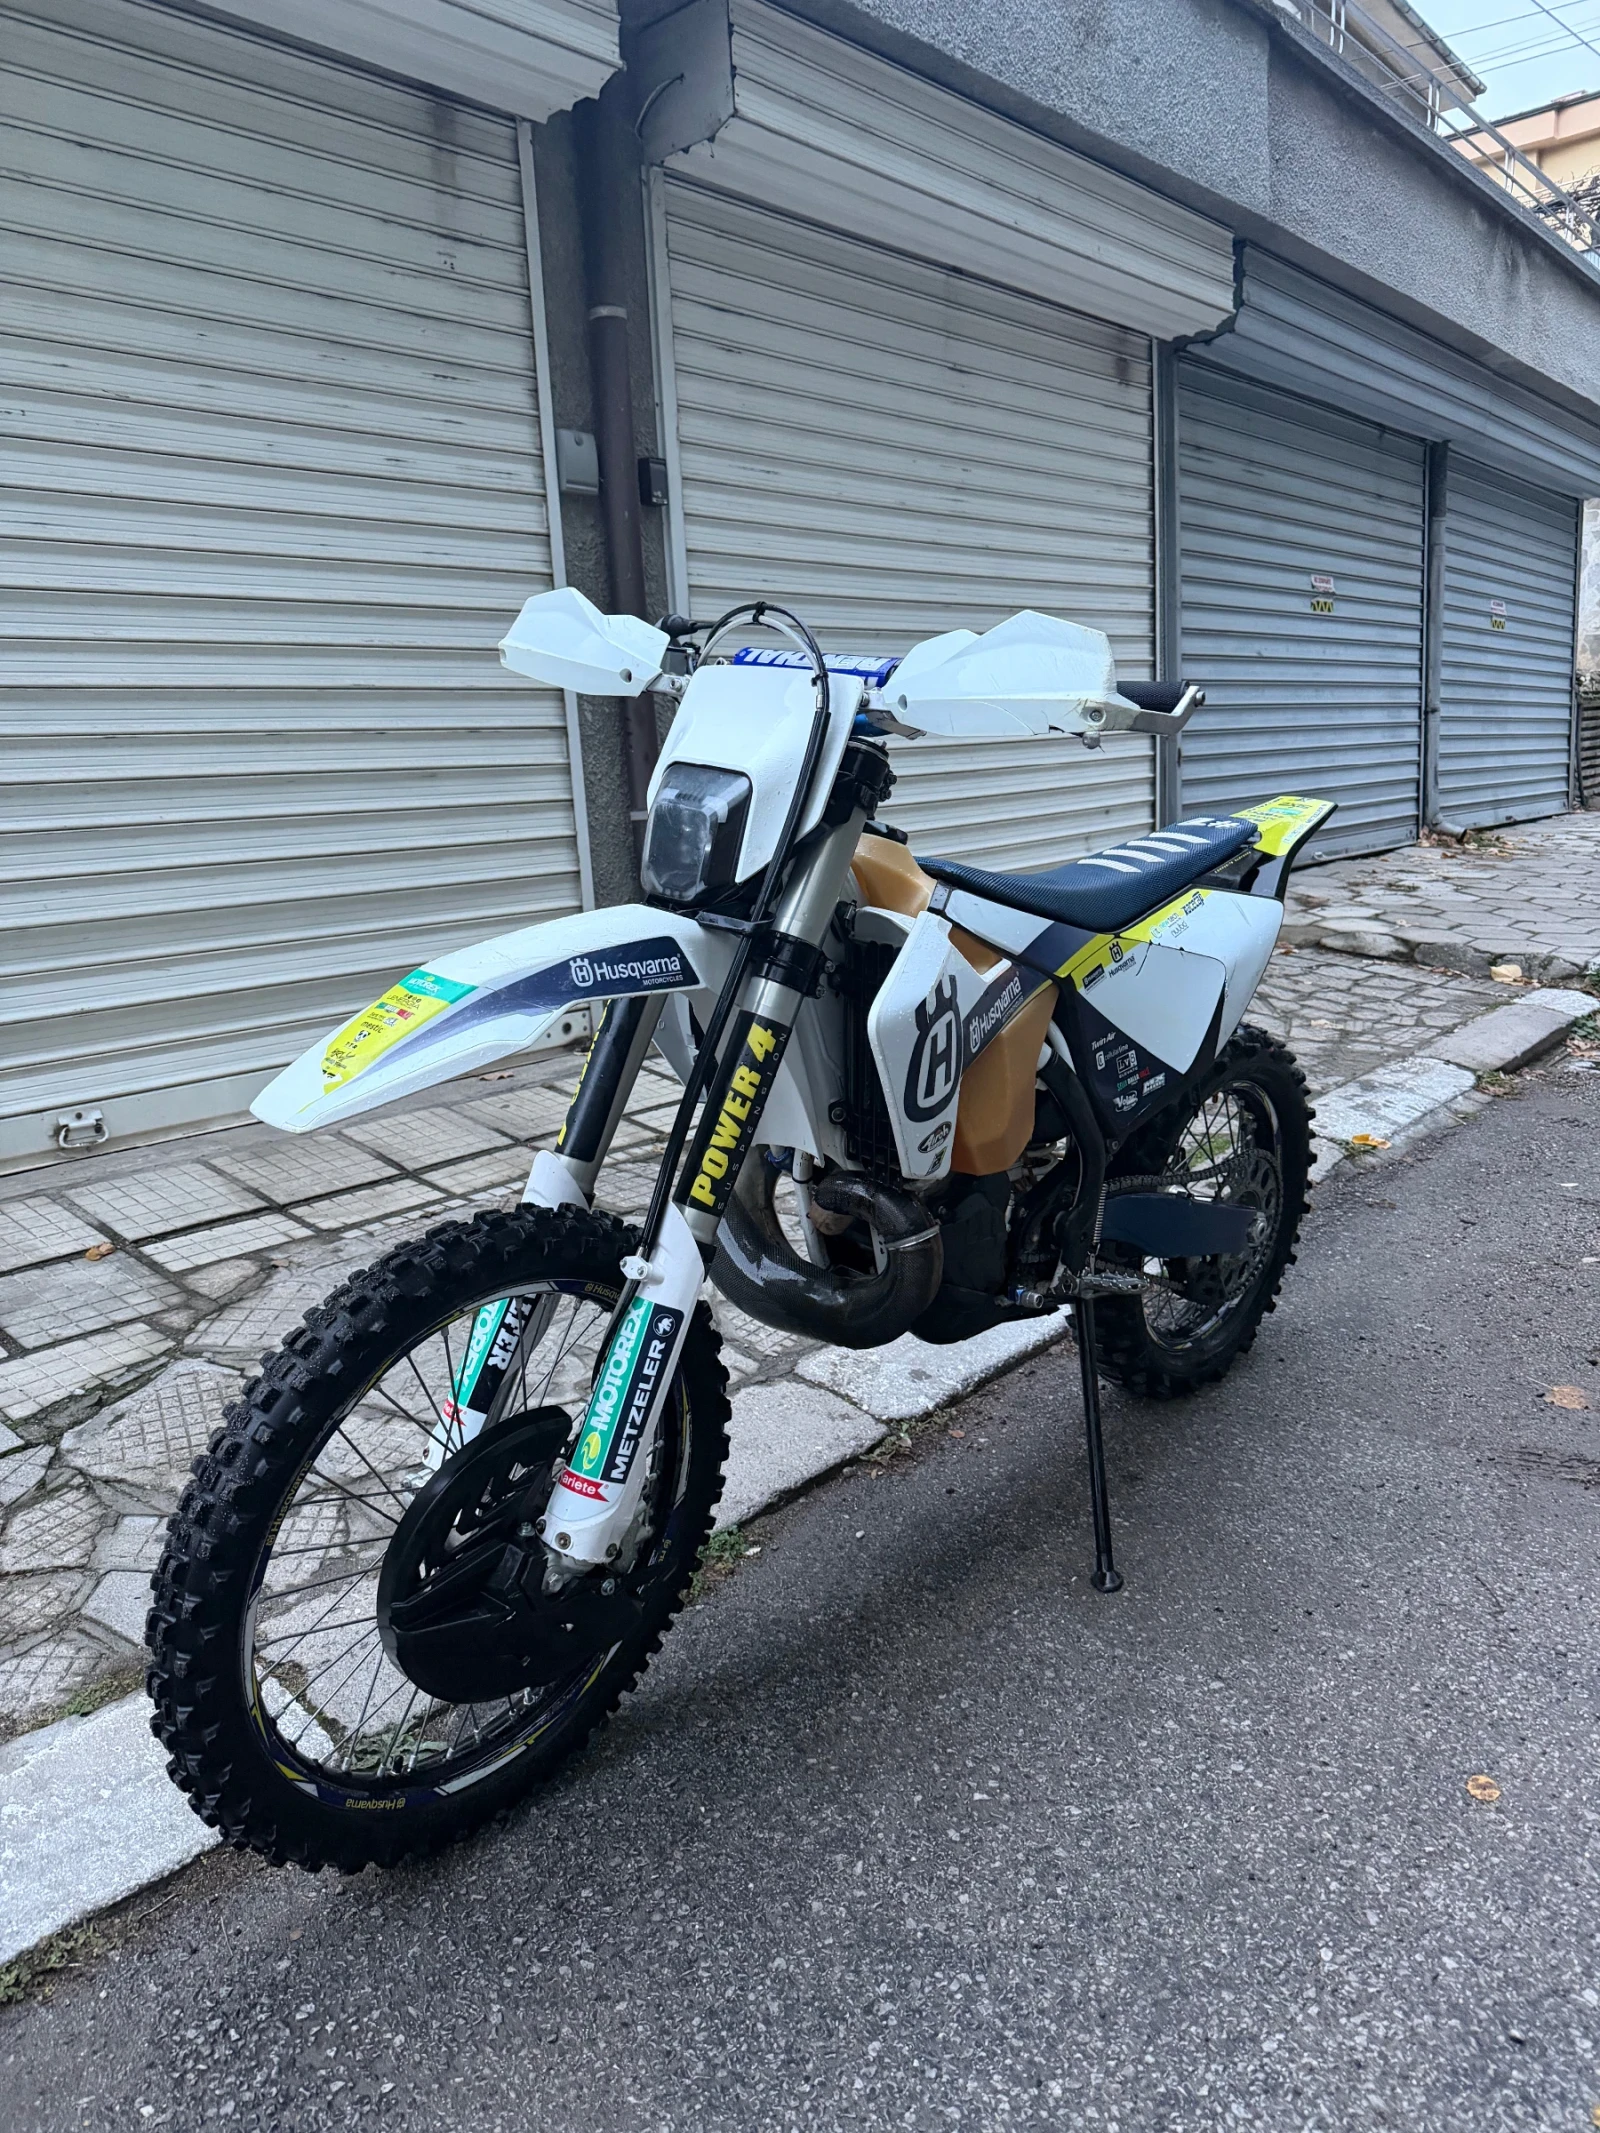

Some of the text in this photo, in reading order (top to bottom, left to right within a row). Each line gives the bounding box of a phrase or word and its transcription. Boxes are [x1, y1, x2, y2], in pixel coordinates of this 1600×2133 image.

[594, 956, 681, 982] Husqvarna
[642, 975, 684, 986] MOTORCYCLES
[980, 976, 1021, 1038] Husqvarna
[361, 1020, 384, 1034] mestic
[1091, 1031, 1117, 1051] Twin Air
[690, 1022, 777, 1207] POWER 4
[593, 1285, 620, 1300] Husqv
[589, 1299, 647, 1431] MOTOREX
[610, 1339, 666, 1480] METZELER
[562, 1474, 596, 1495] ariete
[345, 1798, 396, 1810] Husqvarna
